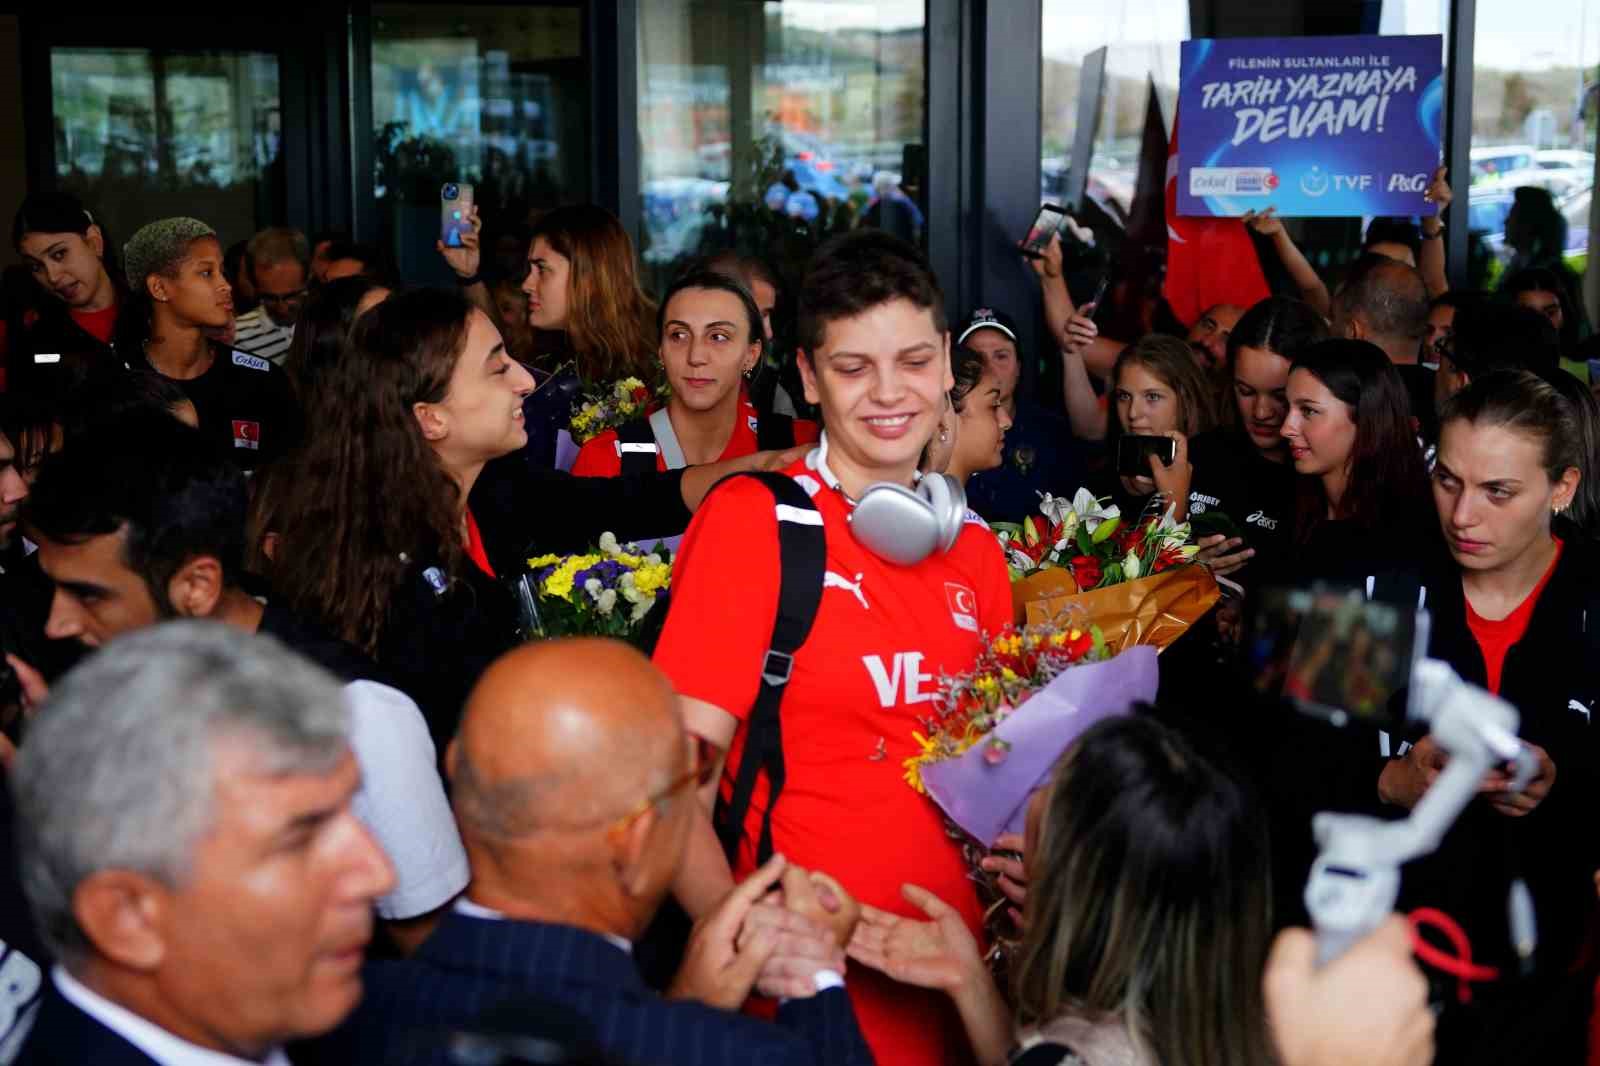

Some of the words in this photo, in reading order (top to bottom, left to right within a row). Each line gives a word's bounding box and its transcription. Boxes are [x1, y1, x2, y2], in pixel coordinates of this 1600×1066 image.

[1229, 57, 1280, 70] FİLENİN
[1284, 55, 1365, 68] SULTANLARI
[1369, 53, 1390, 66] İLE
[1201, 75, 1282, 108] TARİH
[1286, 66, 1417, 103] YAZMAYA
[1232, 95, 1390, 146] DEVAM!
[1334, 175, 1372, 191] TVF
[1387, 173, 1427, 192] P&G
[862, 651, 938, 708] VE
